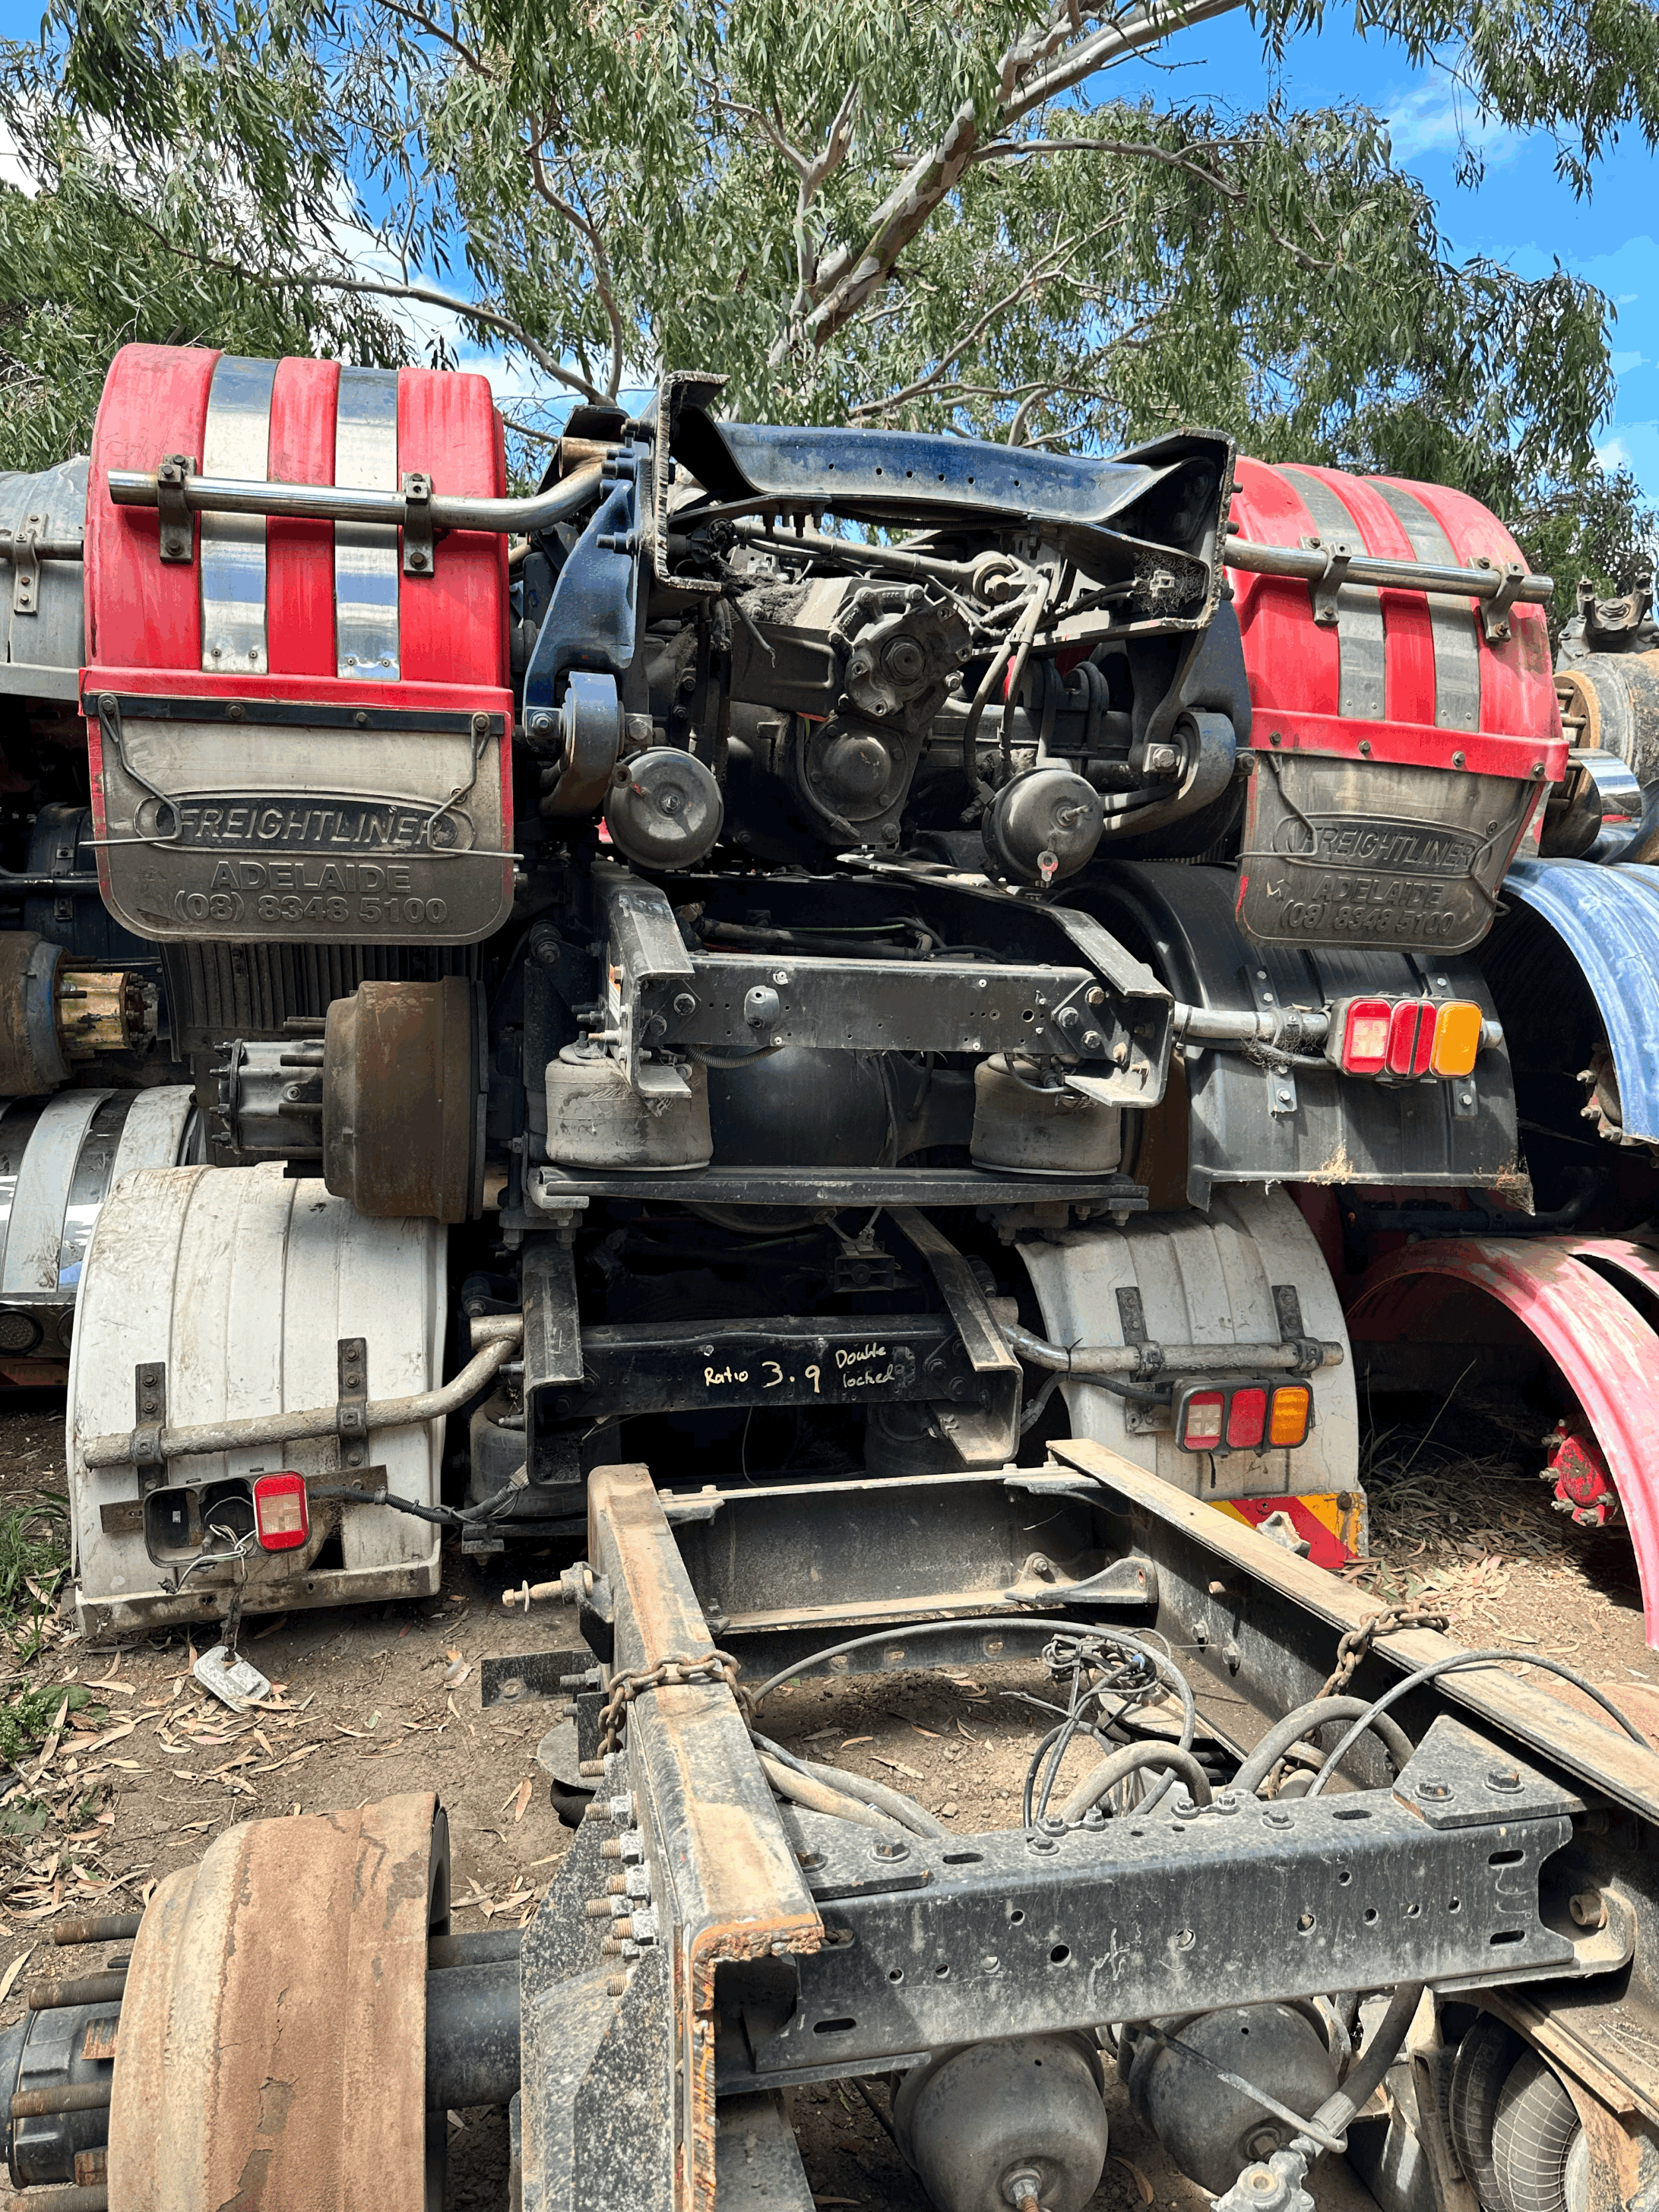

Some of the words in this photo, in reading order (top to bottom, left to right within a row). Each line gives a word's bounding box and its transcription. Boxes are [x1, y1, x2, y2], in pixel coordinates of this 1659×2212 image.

[173, 807, 443, 845] FREIGHTLINER
[210, 861, 411, 893] ADELAIDE
[1311, 874, 1445, 908] ADELAIDE
[174, 890, 244, 922] (08)
[257, 895, 349, 922] 8348
[359, 897, 447, 924] 5100
[1279, 899, 1329, 930] (08)
[1333, 905, 1394, 932] 8348
[1395, 910, 1455, 936] 5100
[835, 1342, 887, 1369] Double
[704, 1366, 749, 1386] Ratio
[762, 1361, 820, 1393] 3.9
[843, 1363, 895, 1388] locked
